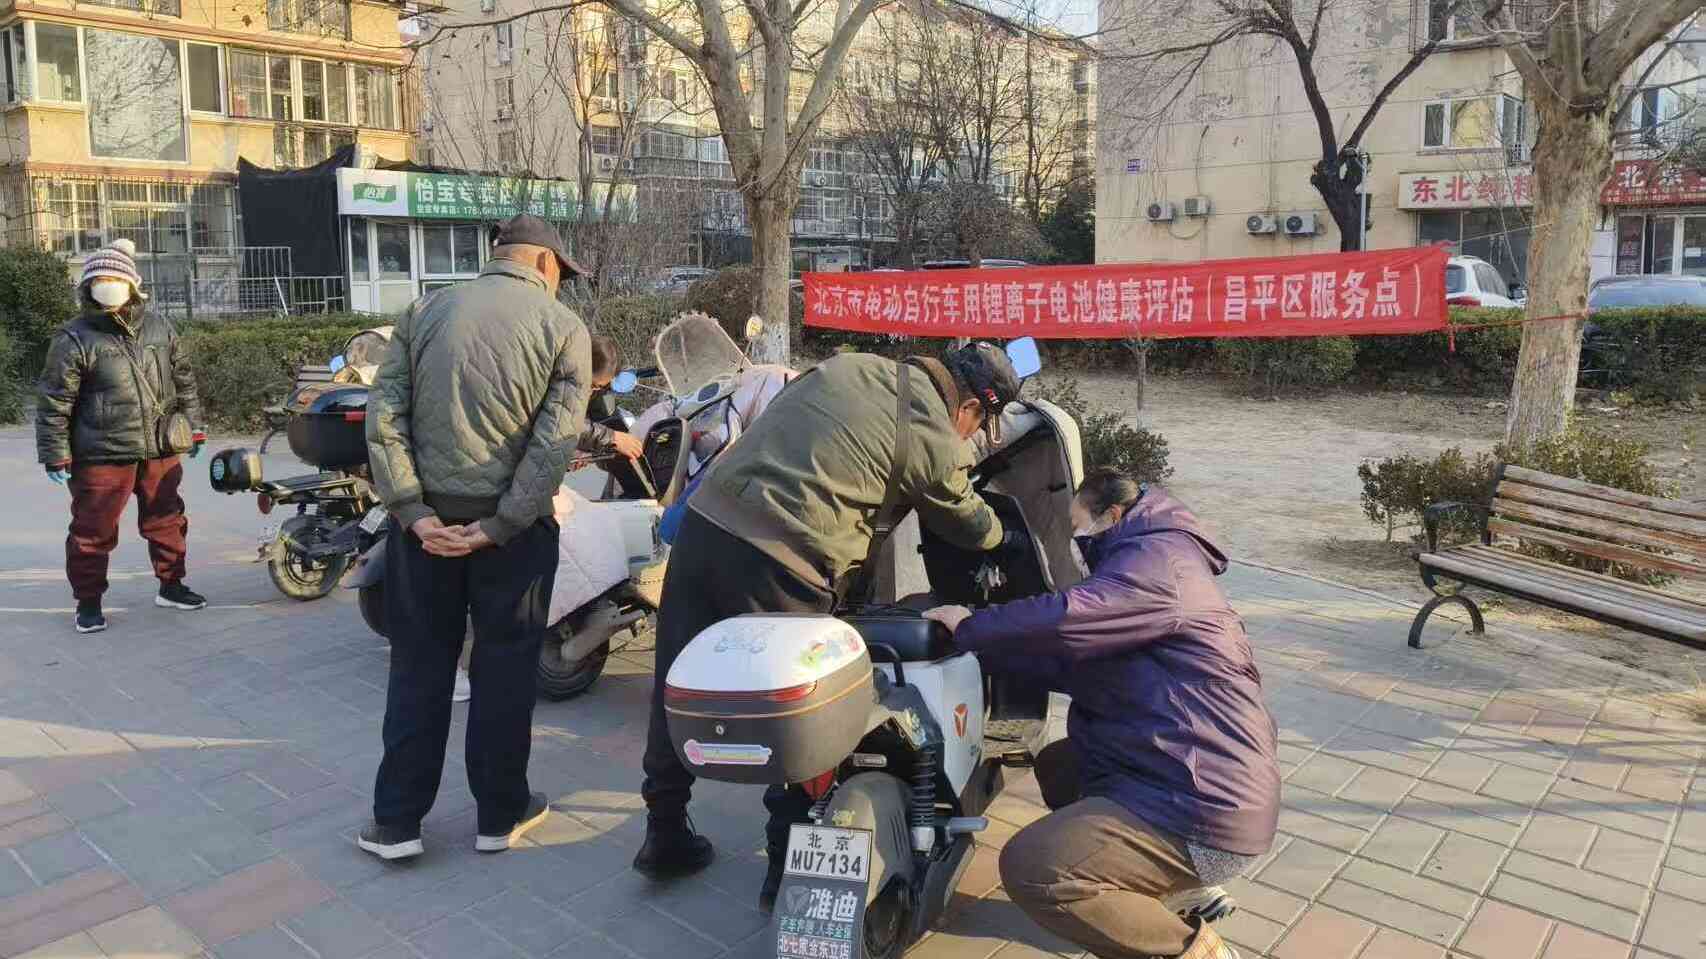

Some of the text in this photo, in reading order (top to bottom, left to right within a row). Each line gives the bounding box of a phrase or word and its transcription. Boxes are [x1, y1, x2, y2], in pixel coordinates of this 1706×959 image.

[808, 832, 850, 851] 北京
[790, 850, 861, 876] MU7134
[805, 888, 858, 922] 雅迪
